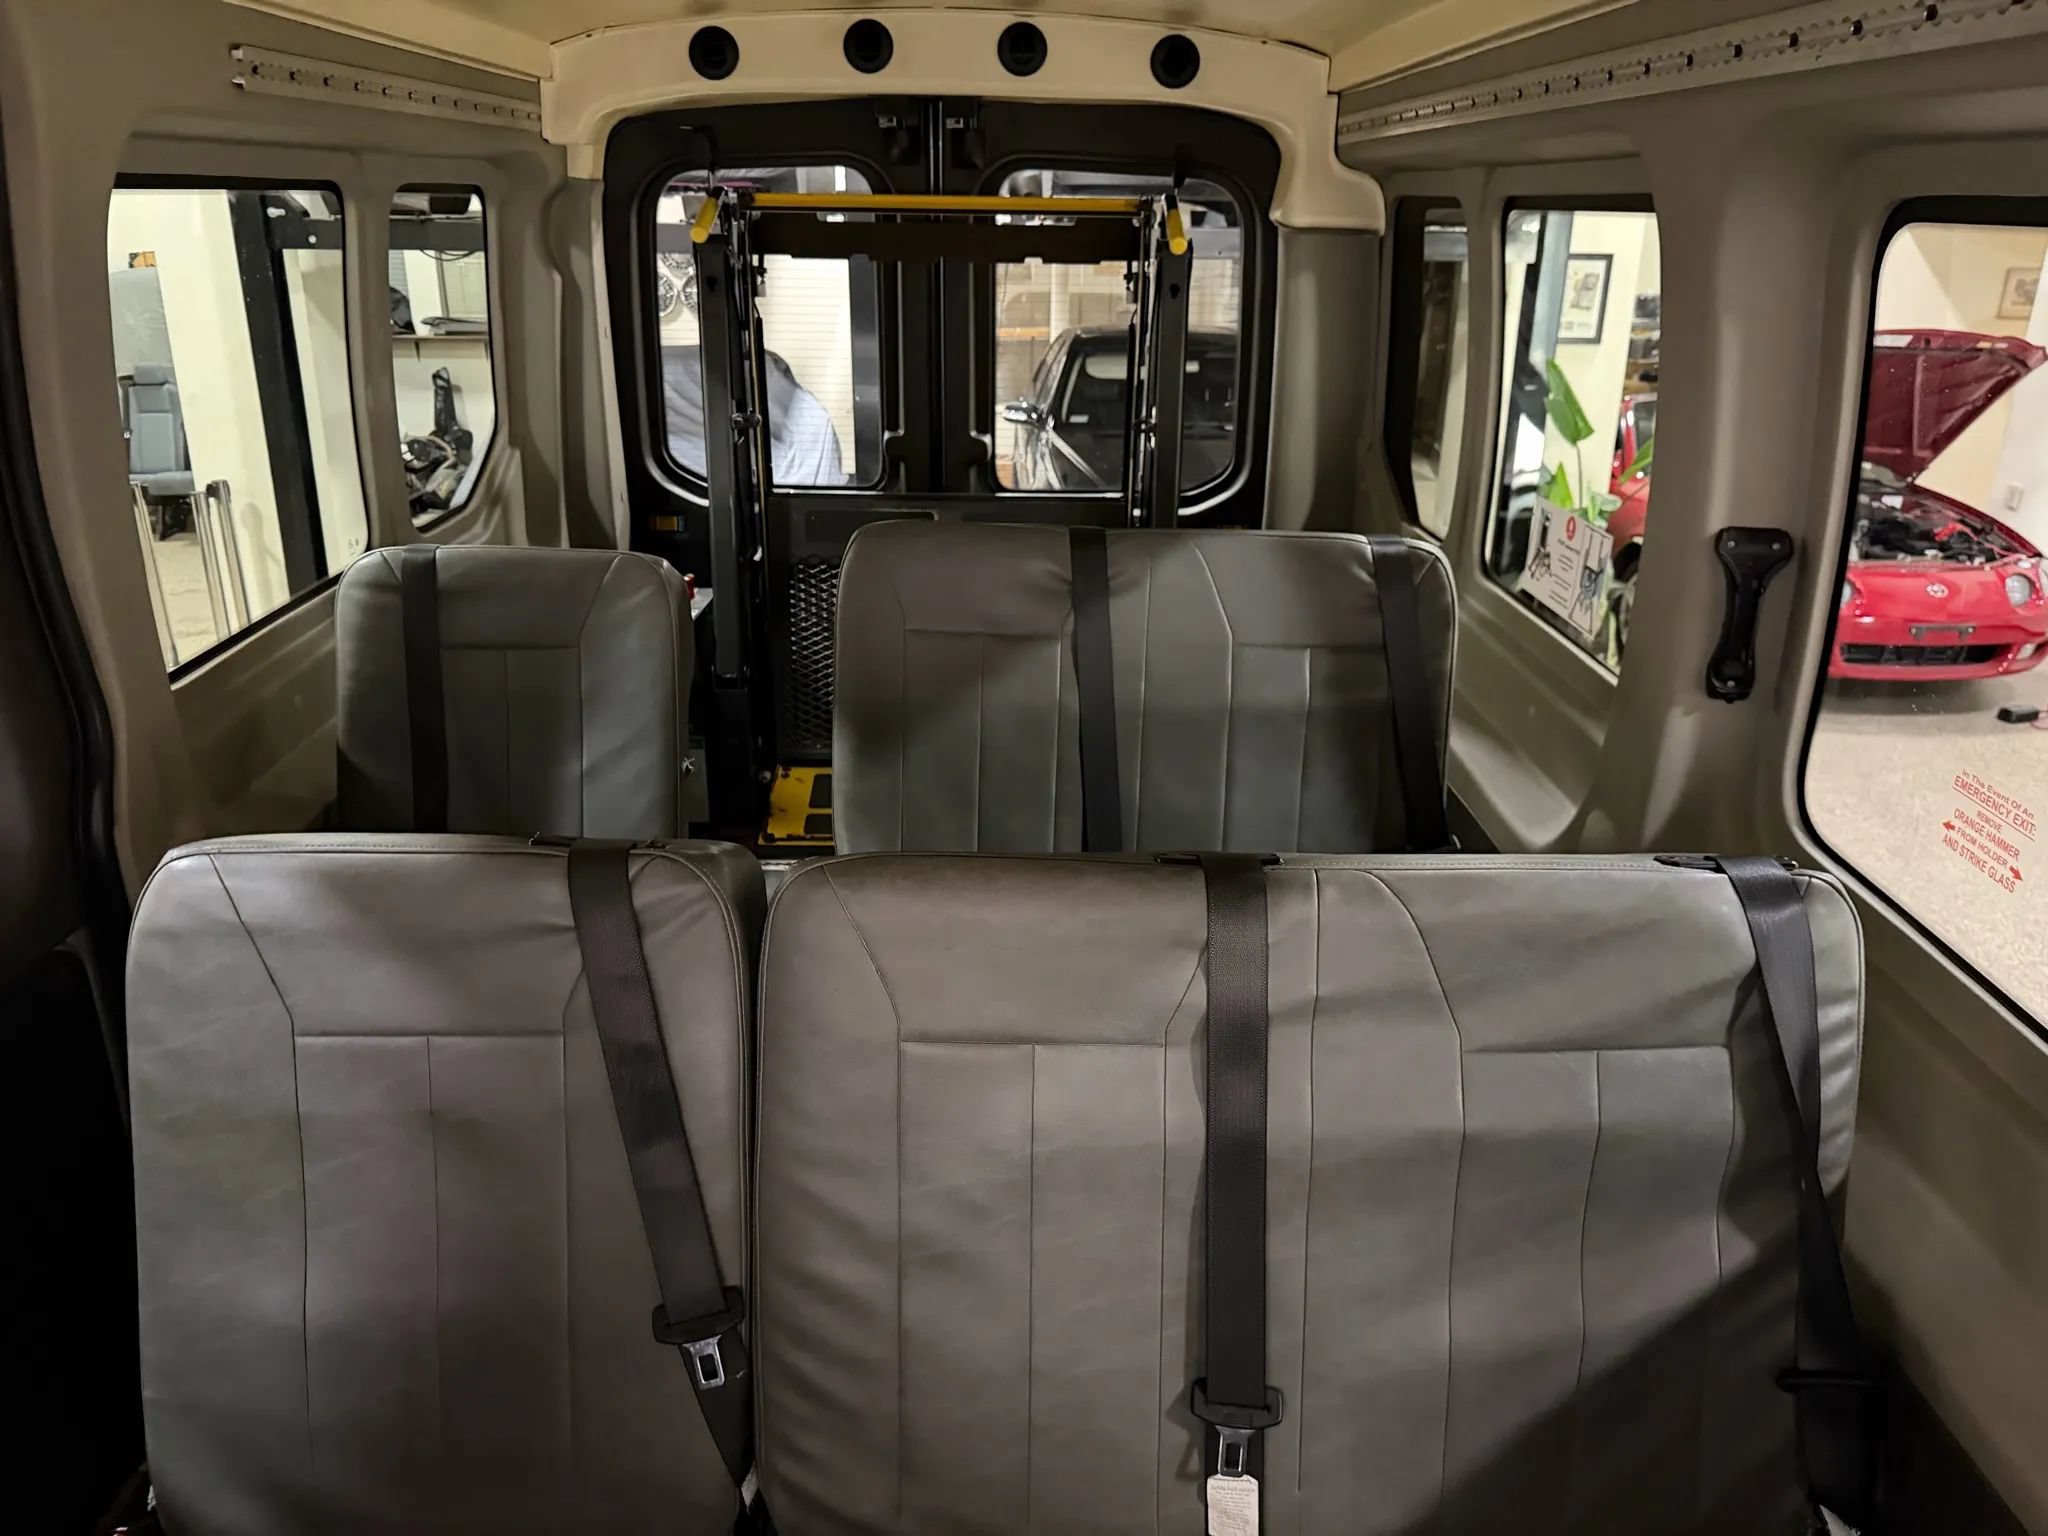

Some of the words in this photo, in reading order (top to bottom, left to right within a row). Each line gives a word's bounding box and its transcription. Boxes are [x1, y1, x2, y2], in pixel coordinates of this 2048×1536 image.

[1955, 775, 2012, 819] EMERGENCY
[1962, 769, 1970, 779] In
[1972, 774, 1985, 789] The
[1987, 784, 2010, 804] Event
[2011, 798, 2021, 810] Of
[2023, 807, 2034, 819] An
[1954, 808, 1985, 836] ORANGE
[1986, 831, 2020, 862] HAMMER
[1977, 810, 2002, 833] REMOVE
[1942, 833, 1959, 852] AND
[1959, 845, 1987, 873] STRIKE
[1988, 866, 2016, 893] GLASS
[1957, 827, 1977, 847] FROM
[1978, 842, 2008, 869] HOLDER
